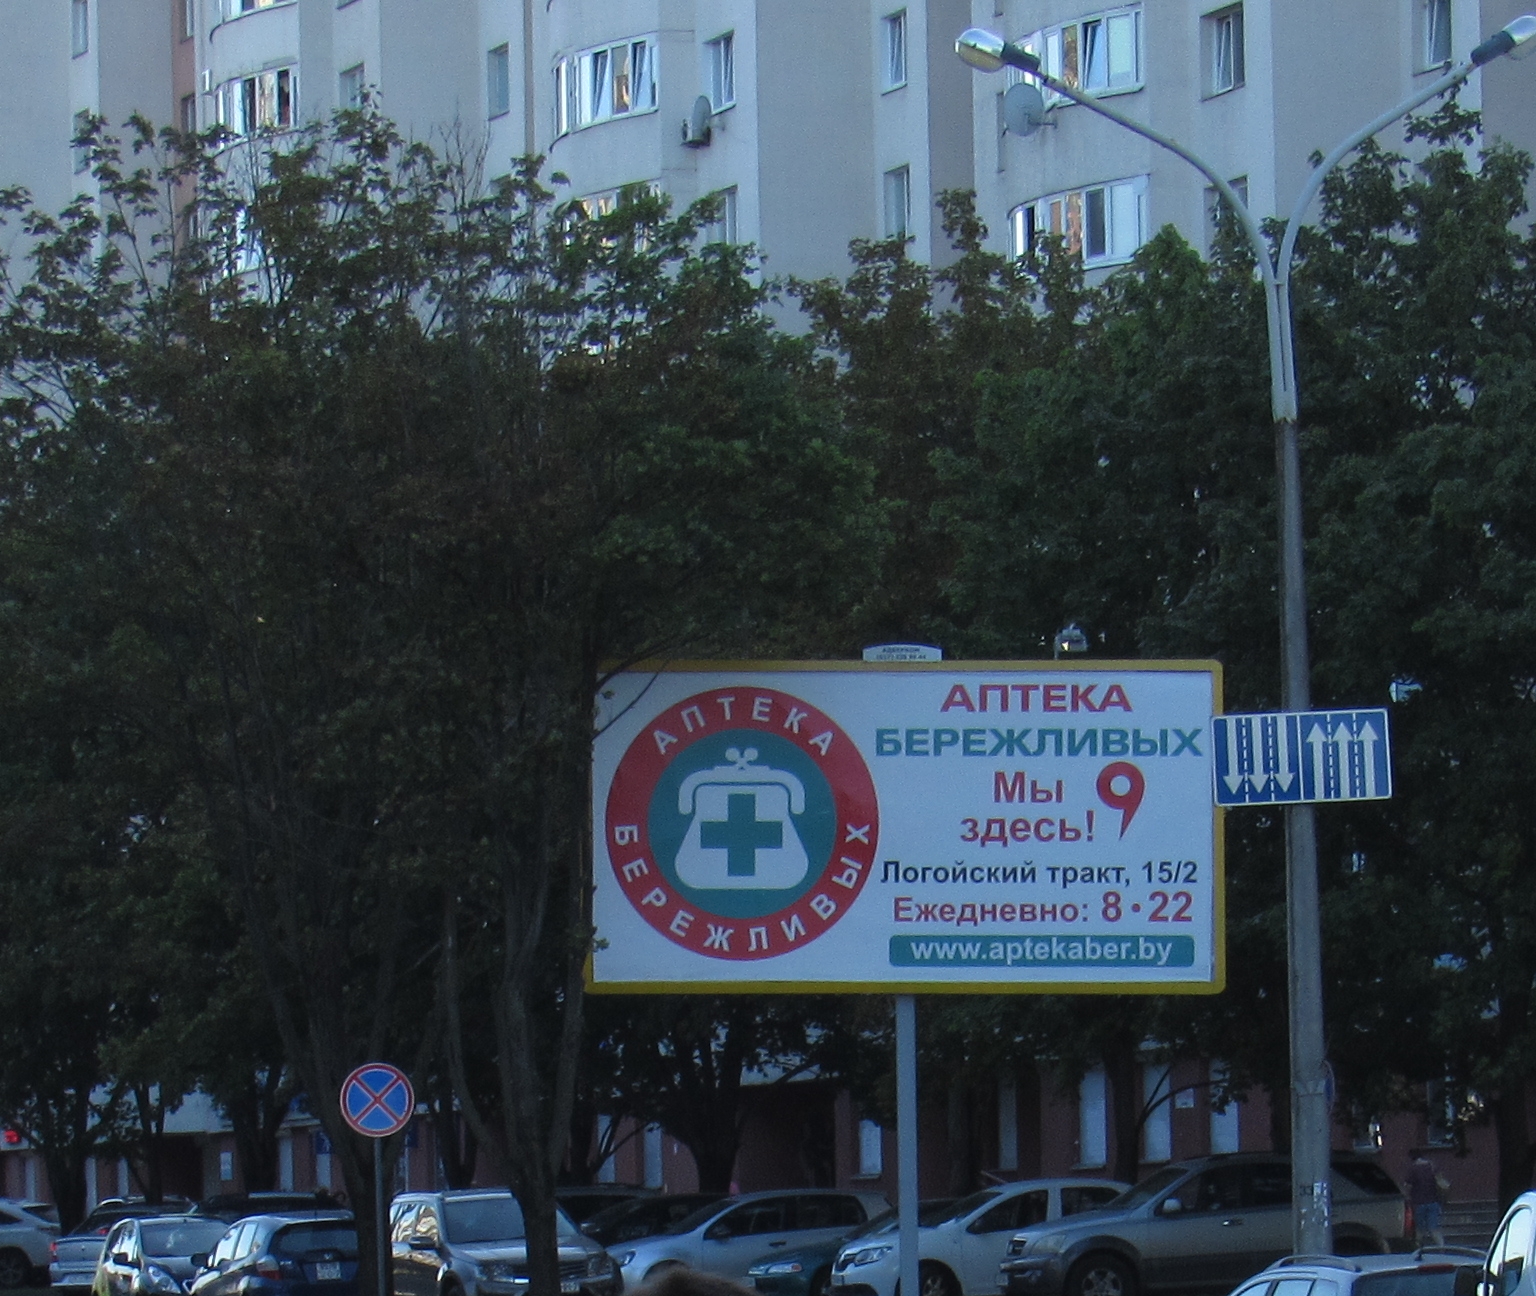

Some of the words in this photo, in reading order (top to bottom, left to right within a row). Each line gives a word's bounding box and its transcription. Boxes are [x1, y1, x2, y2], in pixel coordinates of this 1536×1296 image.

[939, 683, 1133, 713] АПТЕКА
[652, 696, 834, 756] АПТЕКА
[875, 727, 1204, 757] БЕРЕЖЛИВЫХ
[993, 770, 1064, 803] Мы
[959, 809, 1095, 848] здесь!
[614, 823, 871, 952] БЕРЕЖЛИВЫХ
[880, 860, 1037, 884] Логойский
[1045, 865, 1131, 888] тракт,
[1141, 860, 1198, 884] 15/2
[893, 896, 1089, 927] Ежедневно:
[910, 937, 1173, 965] www.aptekaber.by
